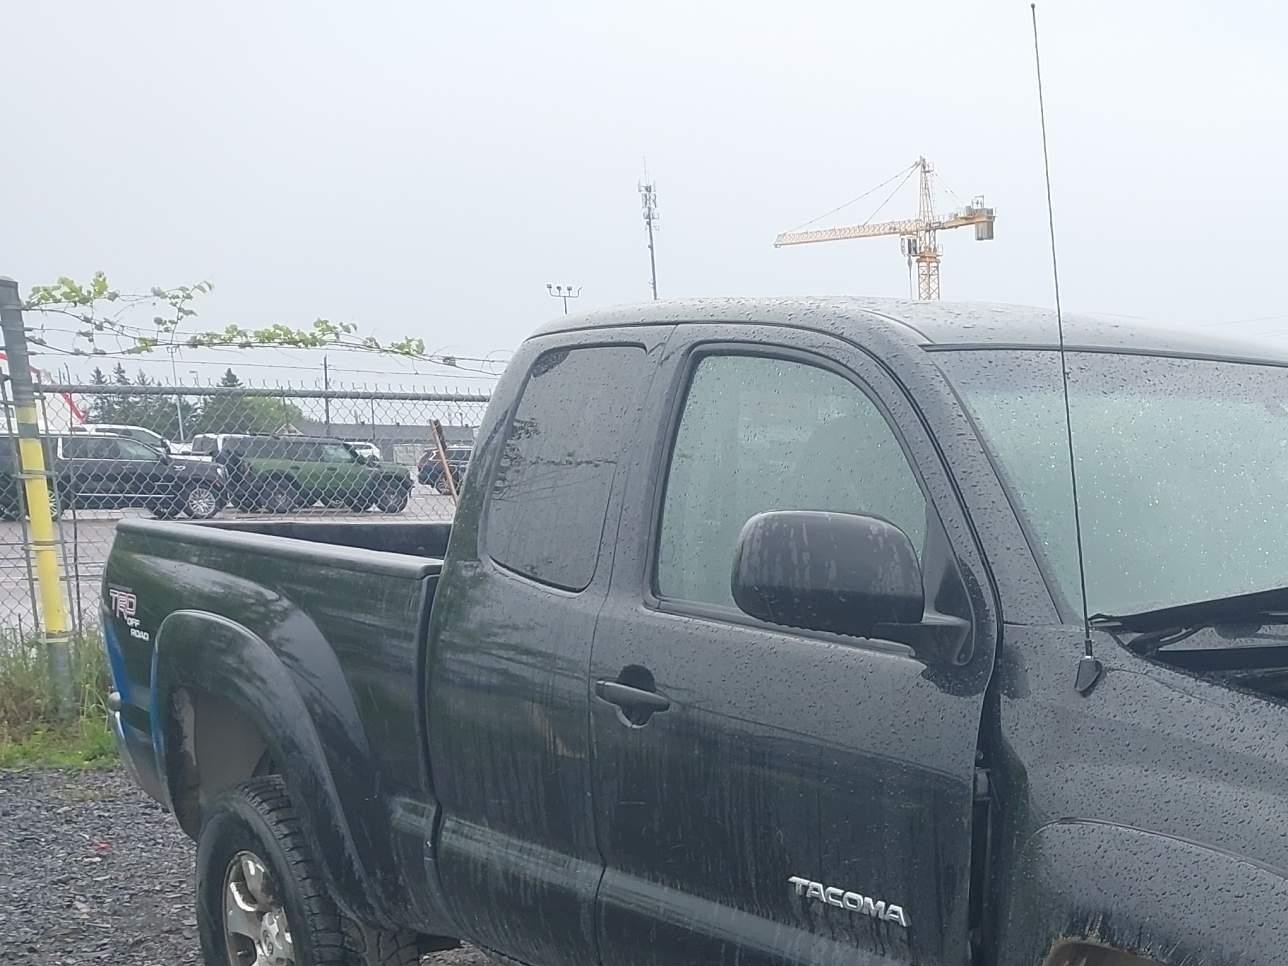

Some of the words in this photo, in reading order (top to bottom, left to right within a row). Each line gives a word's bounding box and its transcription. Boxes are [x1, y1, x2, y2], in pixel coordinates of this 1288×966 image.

[110, 589, 137, 620] TRD
[127, 617, 140, 627] OFF
[130, 628, 149, 641] ROAD
[788, 876, 907, 927] TACOMA
